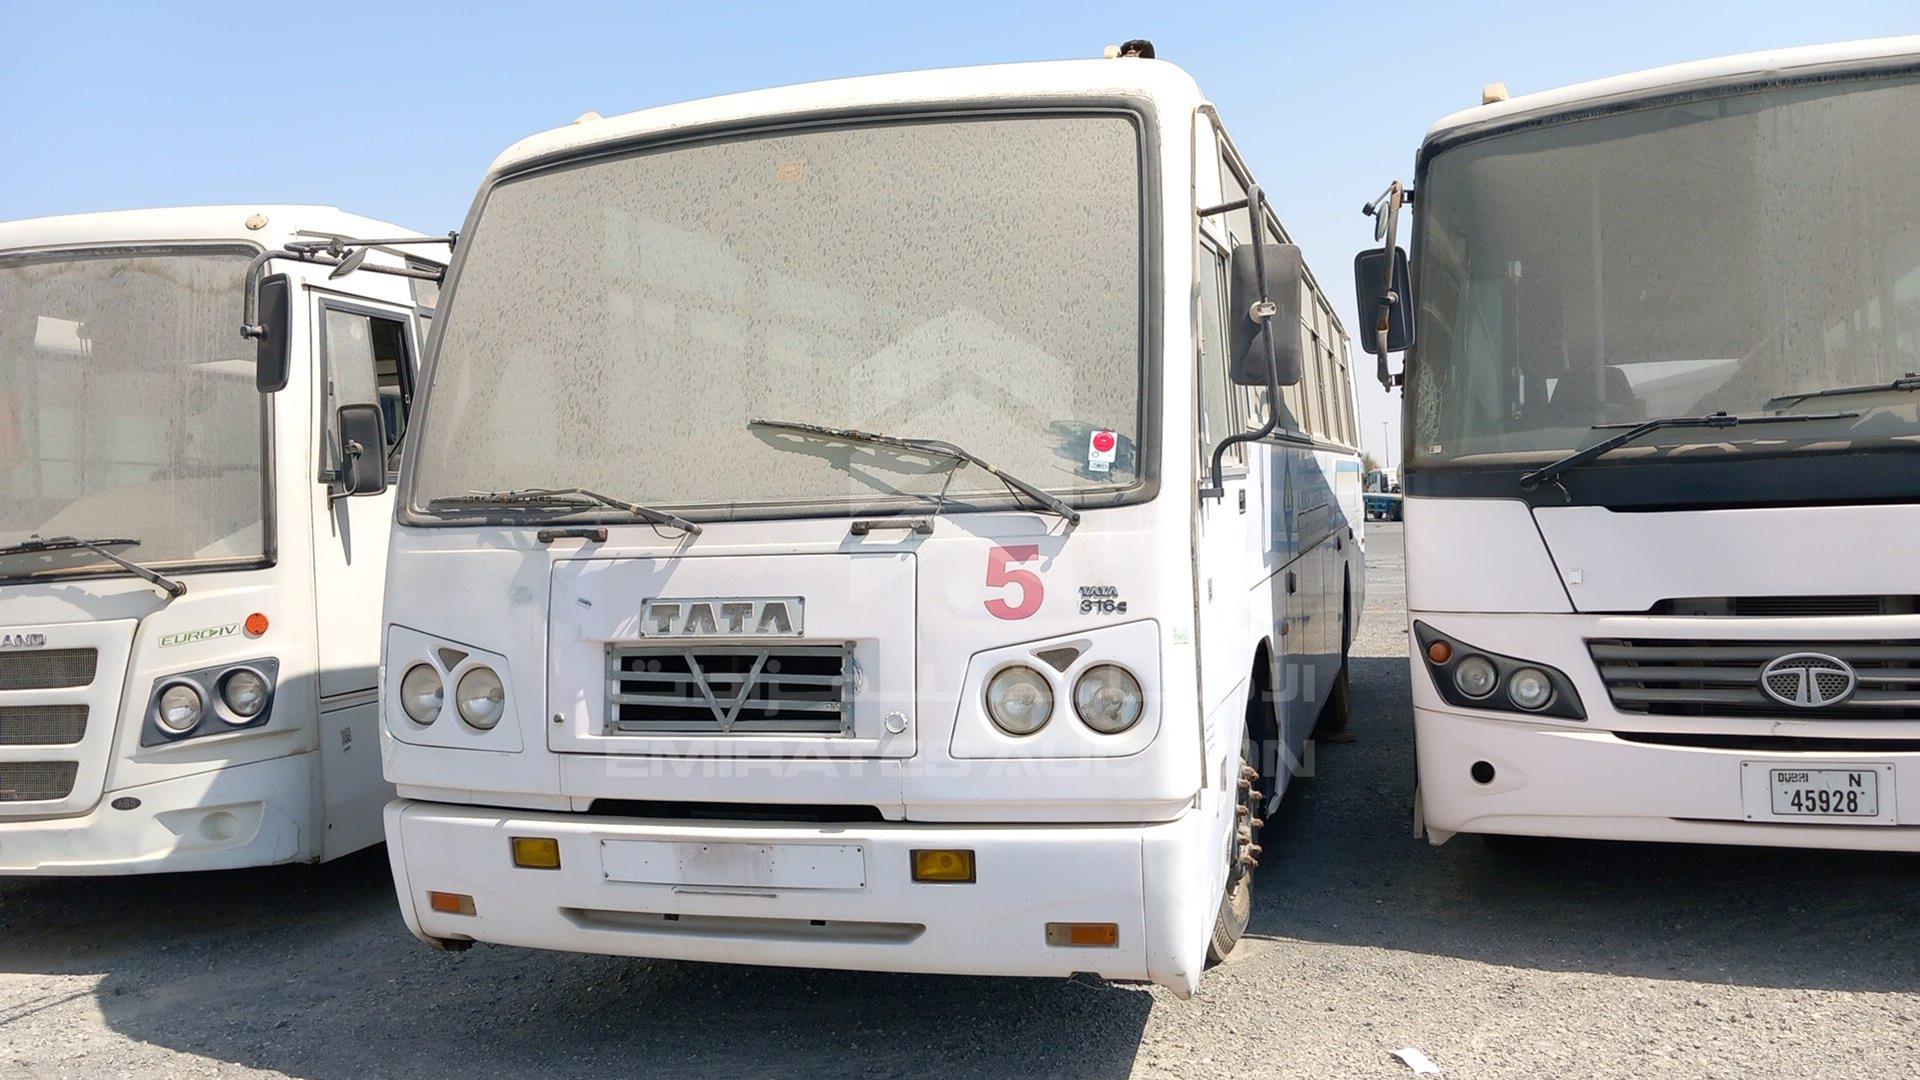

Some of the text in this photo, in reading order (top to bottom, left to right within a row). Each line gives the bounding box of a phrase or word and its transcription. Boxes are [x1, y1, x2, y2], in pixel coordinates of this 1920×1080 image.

[983, 544, 1044, 620] 5
[1079, 586, 1118, 598] TATA
[650, 600, 794, 633] TATA
[1849, 773, 1862, 787] N
[1791, 790, 1858, 813] 45928
